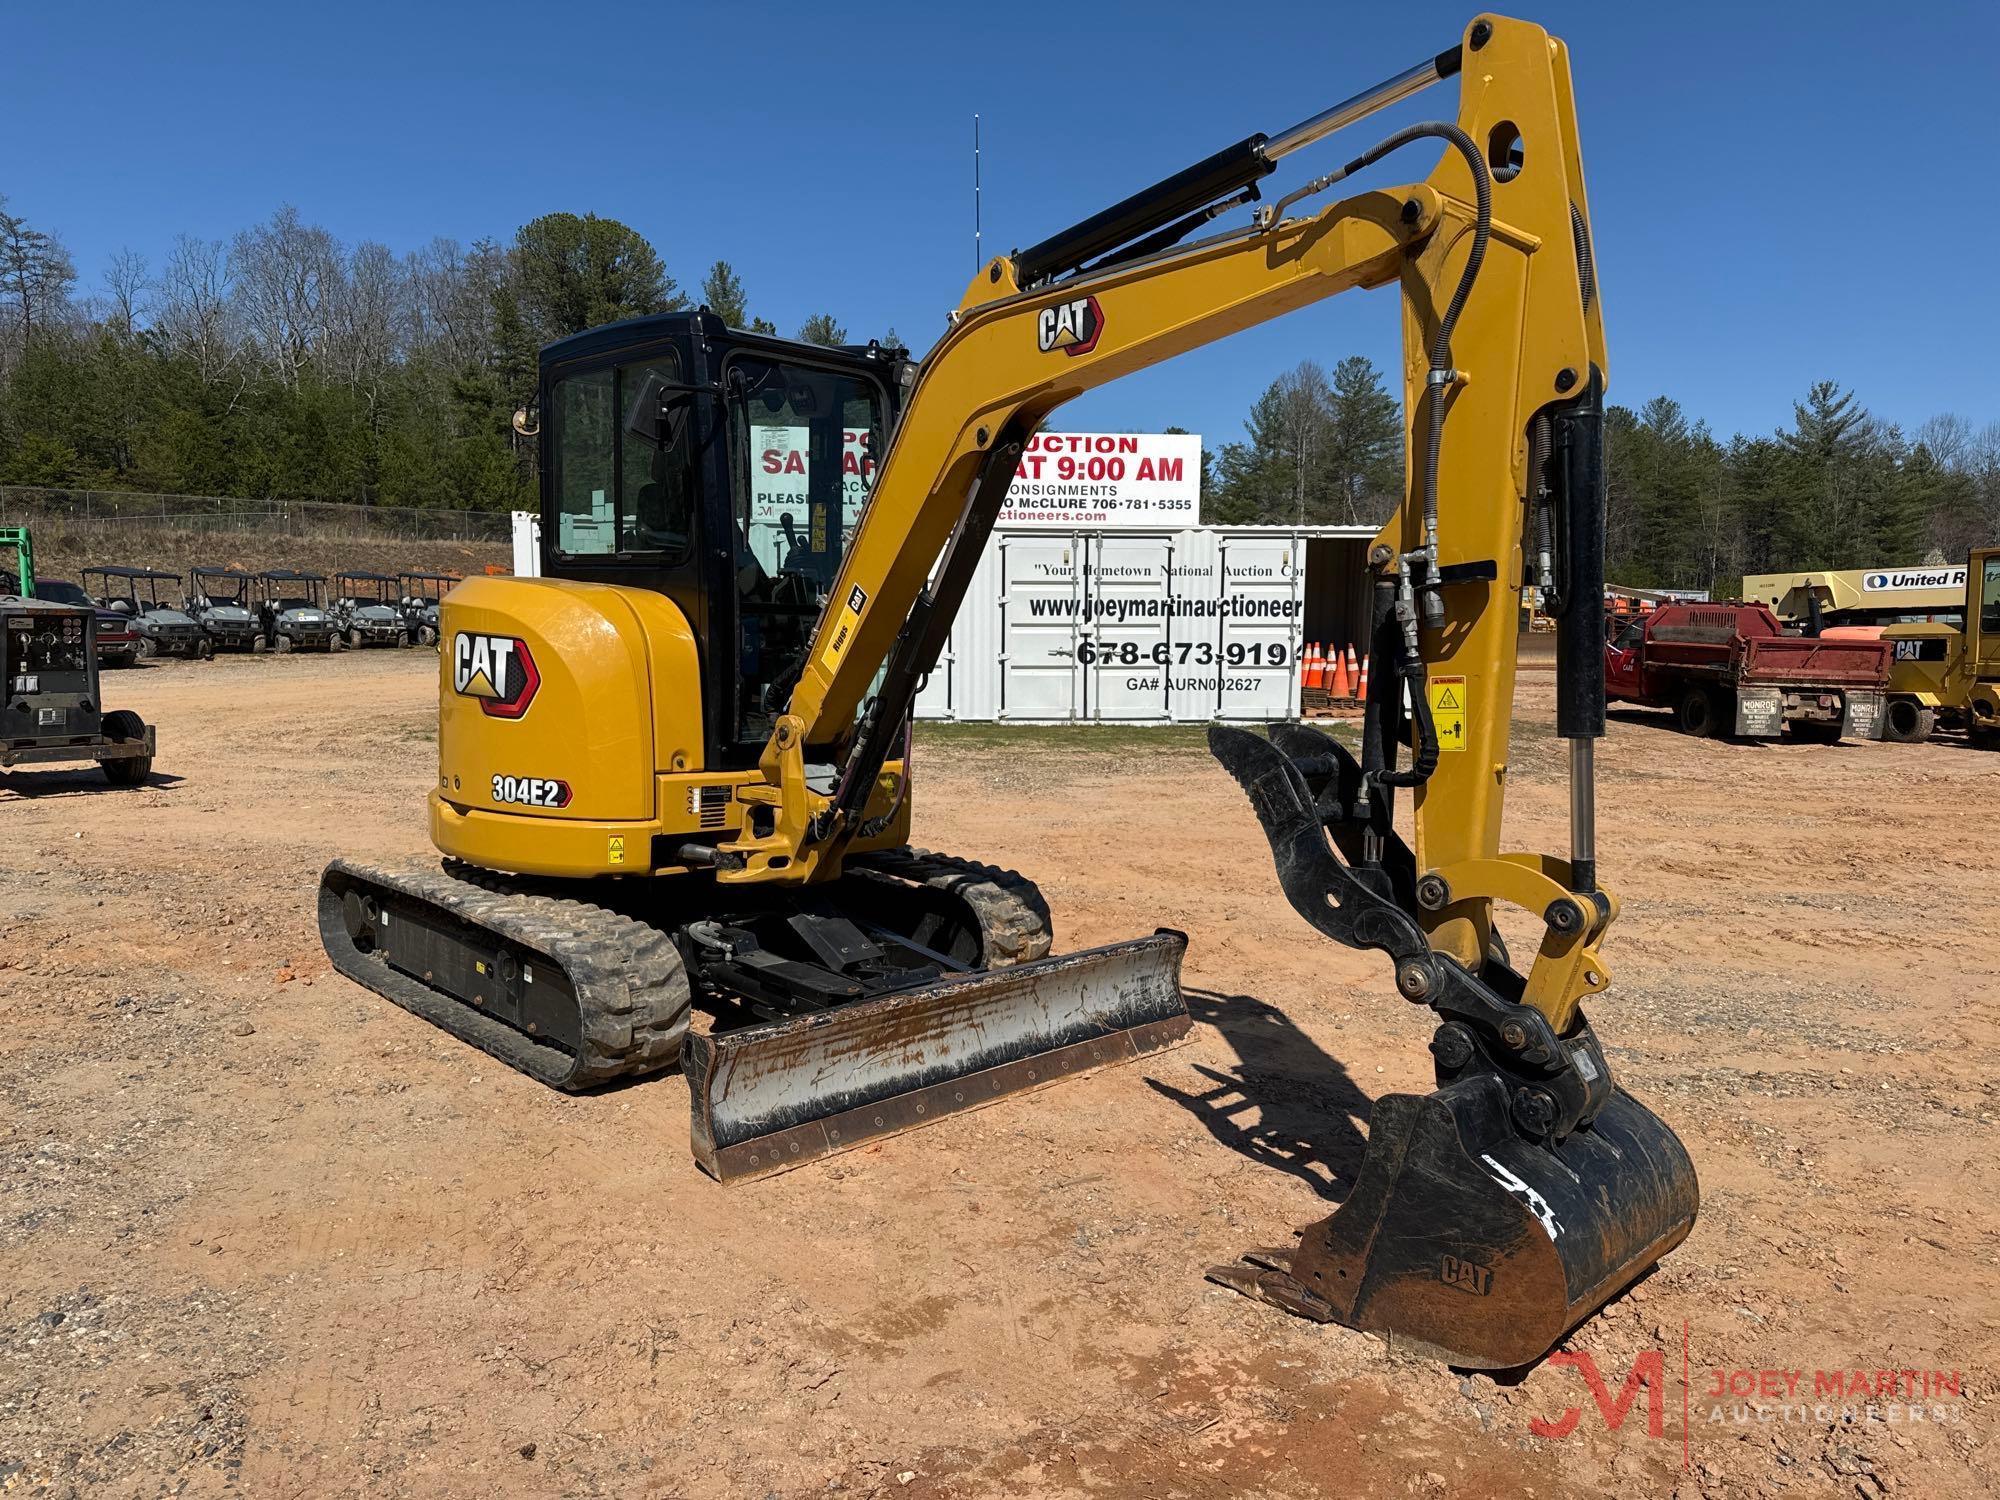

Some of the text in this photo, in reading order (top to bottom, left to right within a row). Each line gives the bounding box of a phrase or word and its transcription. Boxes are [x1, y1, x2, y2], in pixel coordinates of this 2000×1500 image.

[1039, 298, 1089, 351] CAT
[762, 449, 809, 475] SA
[1057, 457, 1126, 481] 9:00
[1136, 458, 1183, 482] AM
[1010, 484, 1118, 497] ONSIGNMENTS
[1019, 498, 1087, 510] McCLURE
[998, 509, 1107, 522] ctioneers.com
[1082, 564, 1152, 577] Hometown
[1160, 564, 1213, 577] National
[1222, 565, 1273, 577] Auction
[1891, 573, 1949, 588] United
[850, 589, 865, 612] CAT
[1896, 641, 1923, 661] CAT
[455, 632, 515, 700] CAT
[1126, 677, 1160, 691] GA#
[1743, 700, 1776, 710] MONROE
[492, 774, 560, 808] 304E2
[1441, 1254, 1490, 1297] CAT
